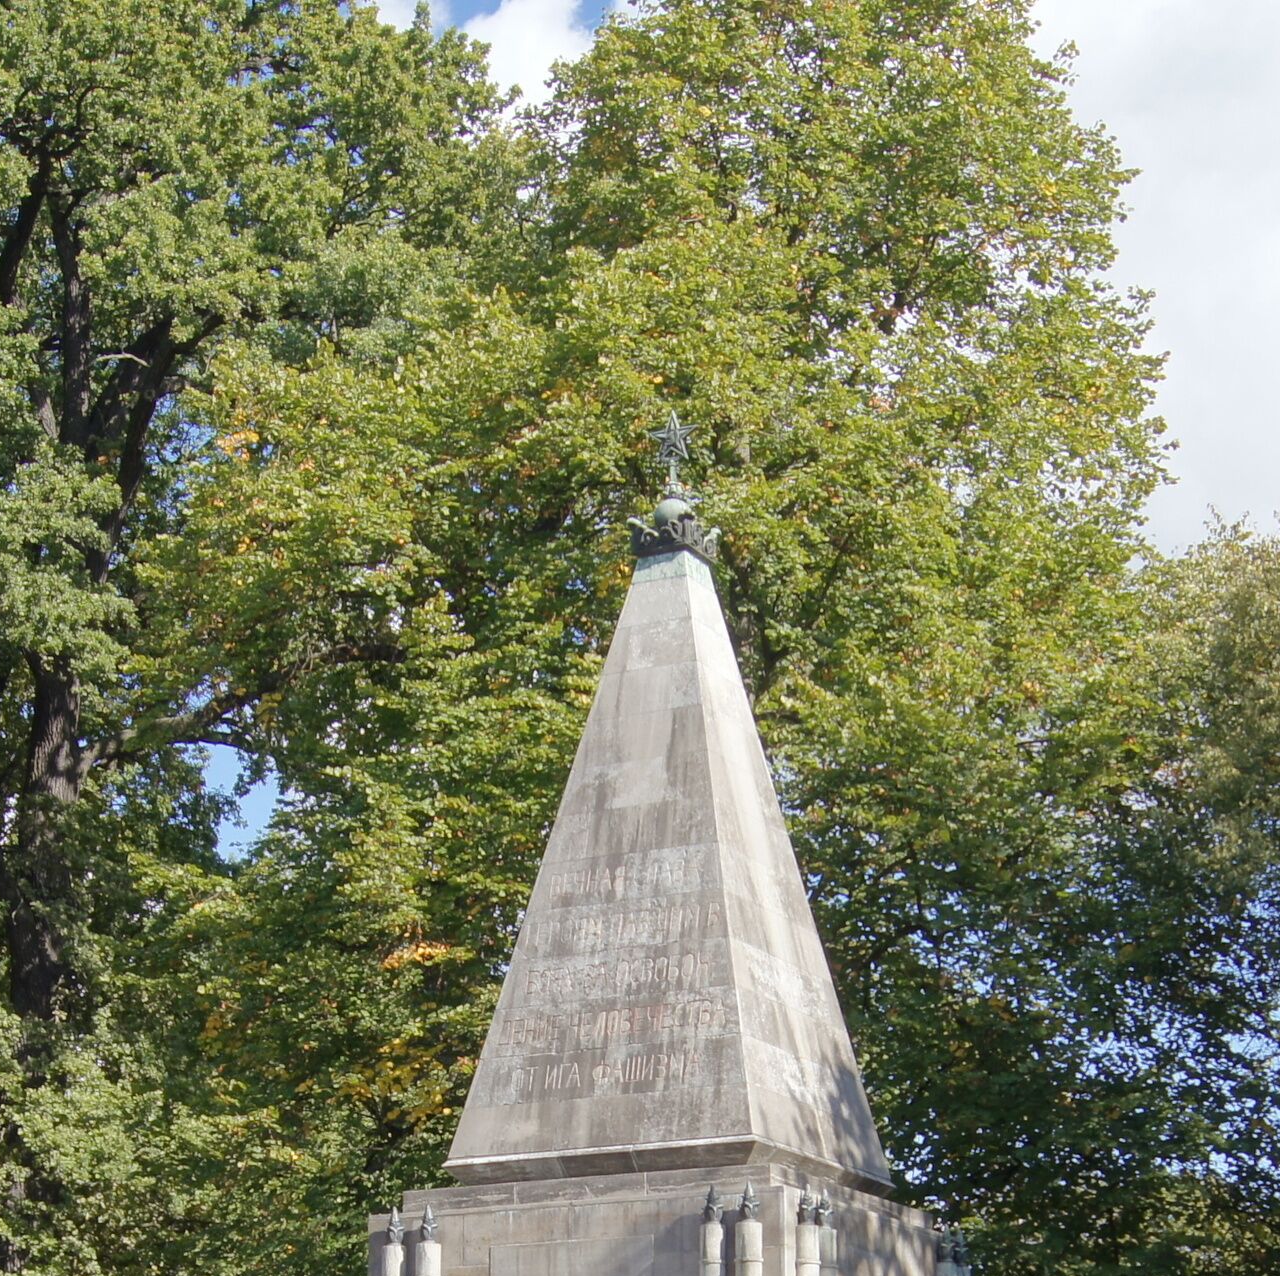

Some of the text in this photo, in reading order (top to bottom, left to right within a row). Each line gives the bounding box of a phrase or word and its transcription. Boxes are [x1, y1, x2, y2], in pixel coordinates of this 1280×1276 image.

[510, 1053, 700, 1093] ОТ ИГА ФАШИЗМА
